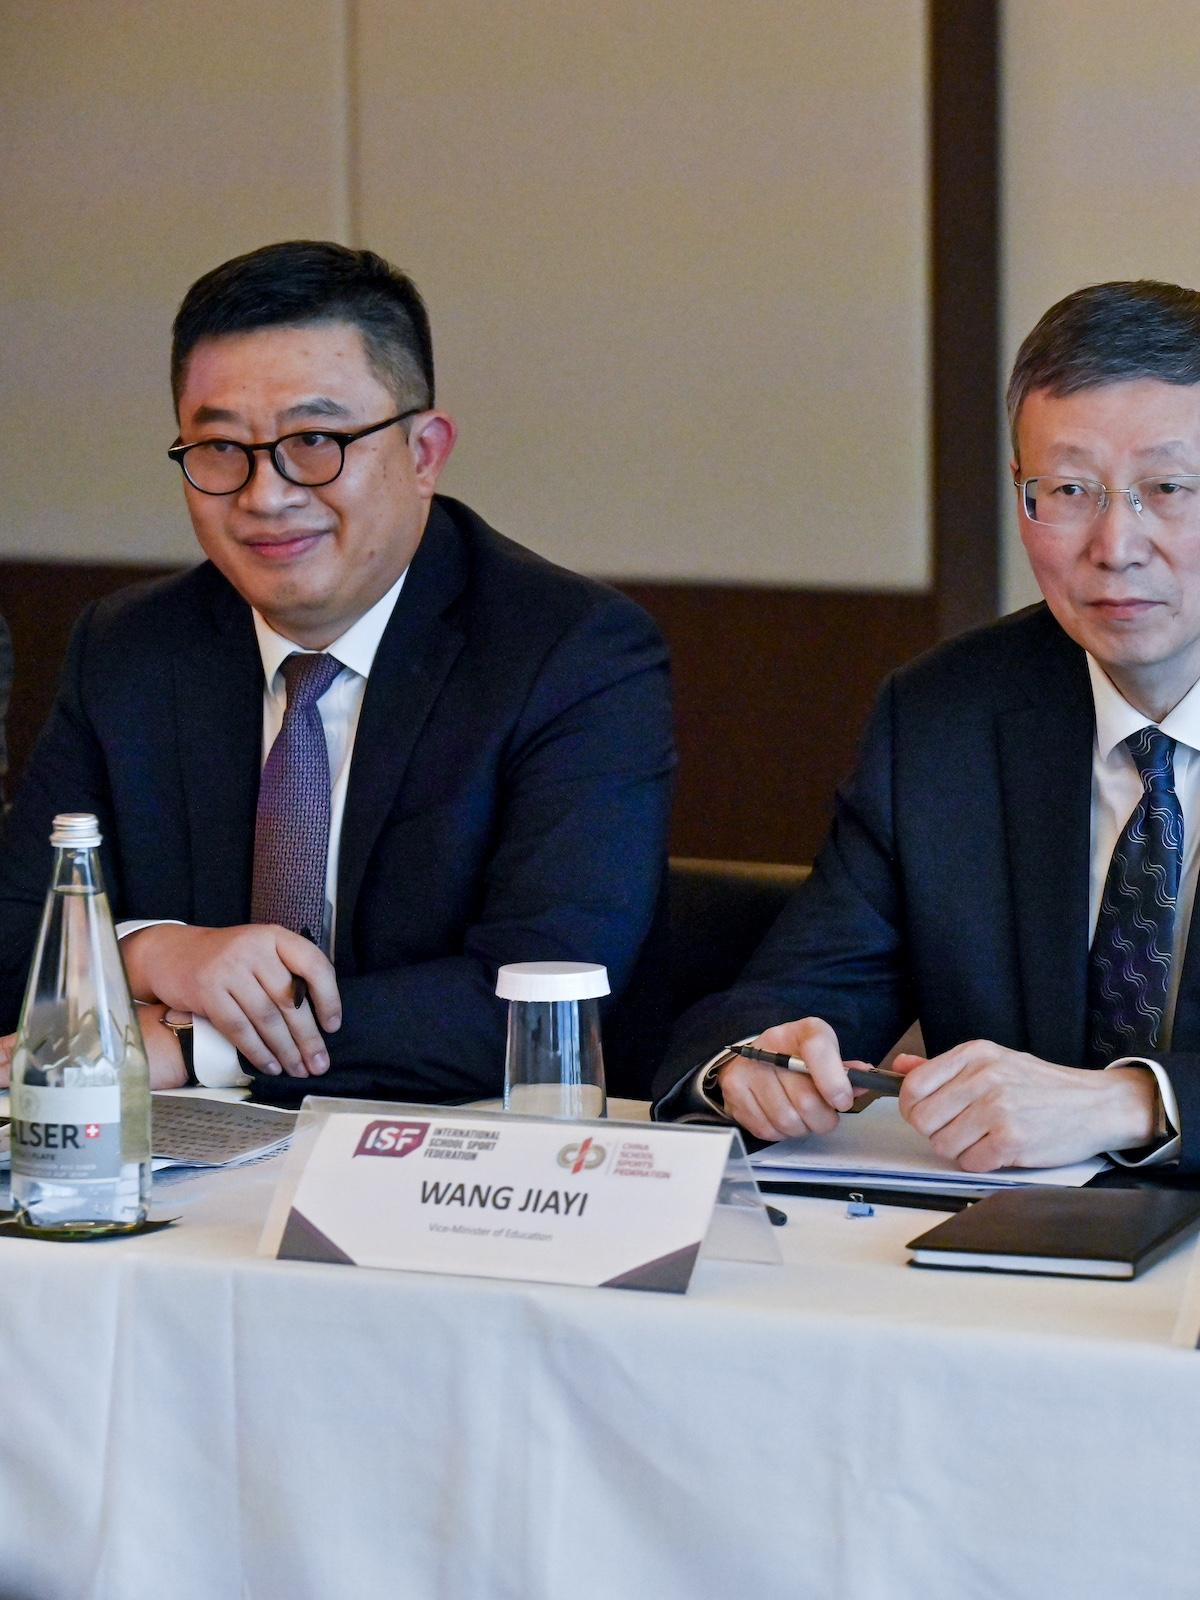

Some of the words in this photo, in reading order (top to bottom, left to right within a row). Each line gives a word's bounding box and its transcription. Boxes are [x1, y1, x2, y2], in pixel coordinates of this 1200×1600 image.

[364, 1126, 421, 1152] ISF
[432, 1127, 500, 1140] INTERNATIONAL
[428, 1138, 464, 1149] SCHOOL
[466, 1140, 497, 1151] SPORT
[424, 1148, 478, 1160] FEDERATION
[420, 1180, 514, 1210] WANG
[518, 1188, 588, 1217] JIAYI
[428, 1222, 491, 1237] Vice-Minister
[492, 1227, 504, 1237] of
[504, 1228, 554, 1242] Education
